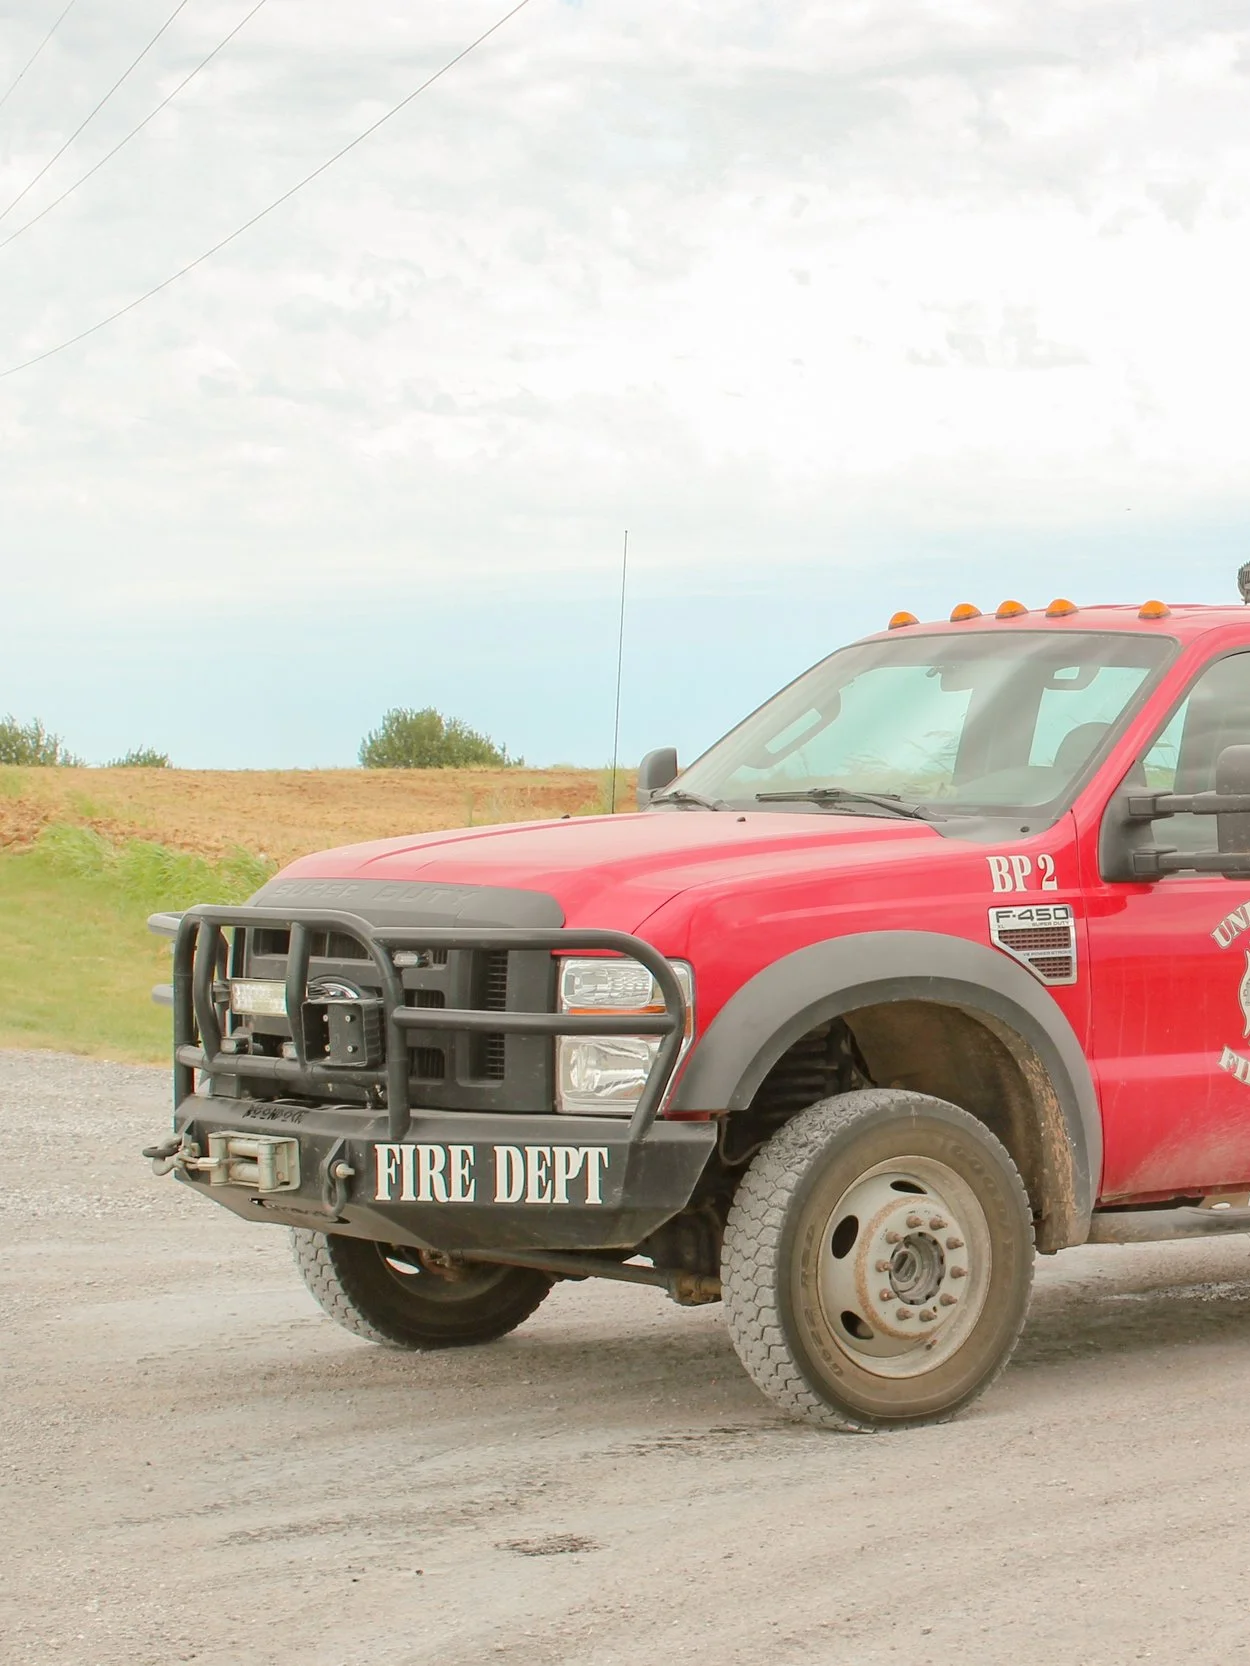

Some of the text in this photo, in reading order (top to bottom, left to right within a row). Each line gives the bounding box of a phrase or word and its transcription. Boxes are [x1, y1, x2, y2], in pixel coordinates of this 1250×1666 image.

[985, 852, 1058, 893] BP 2
[996, 907, 1069, 924] F-450
[374, 1143, 609, 1205] FIRE DEPT
